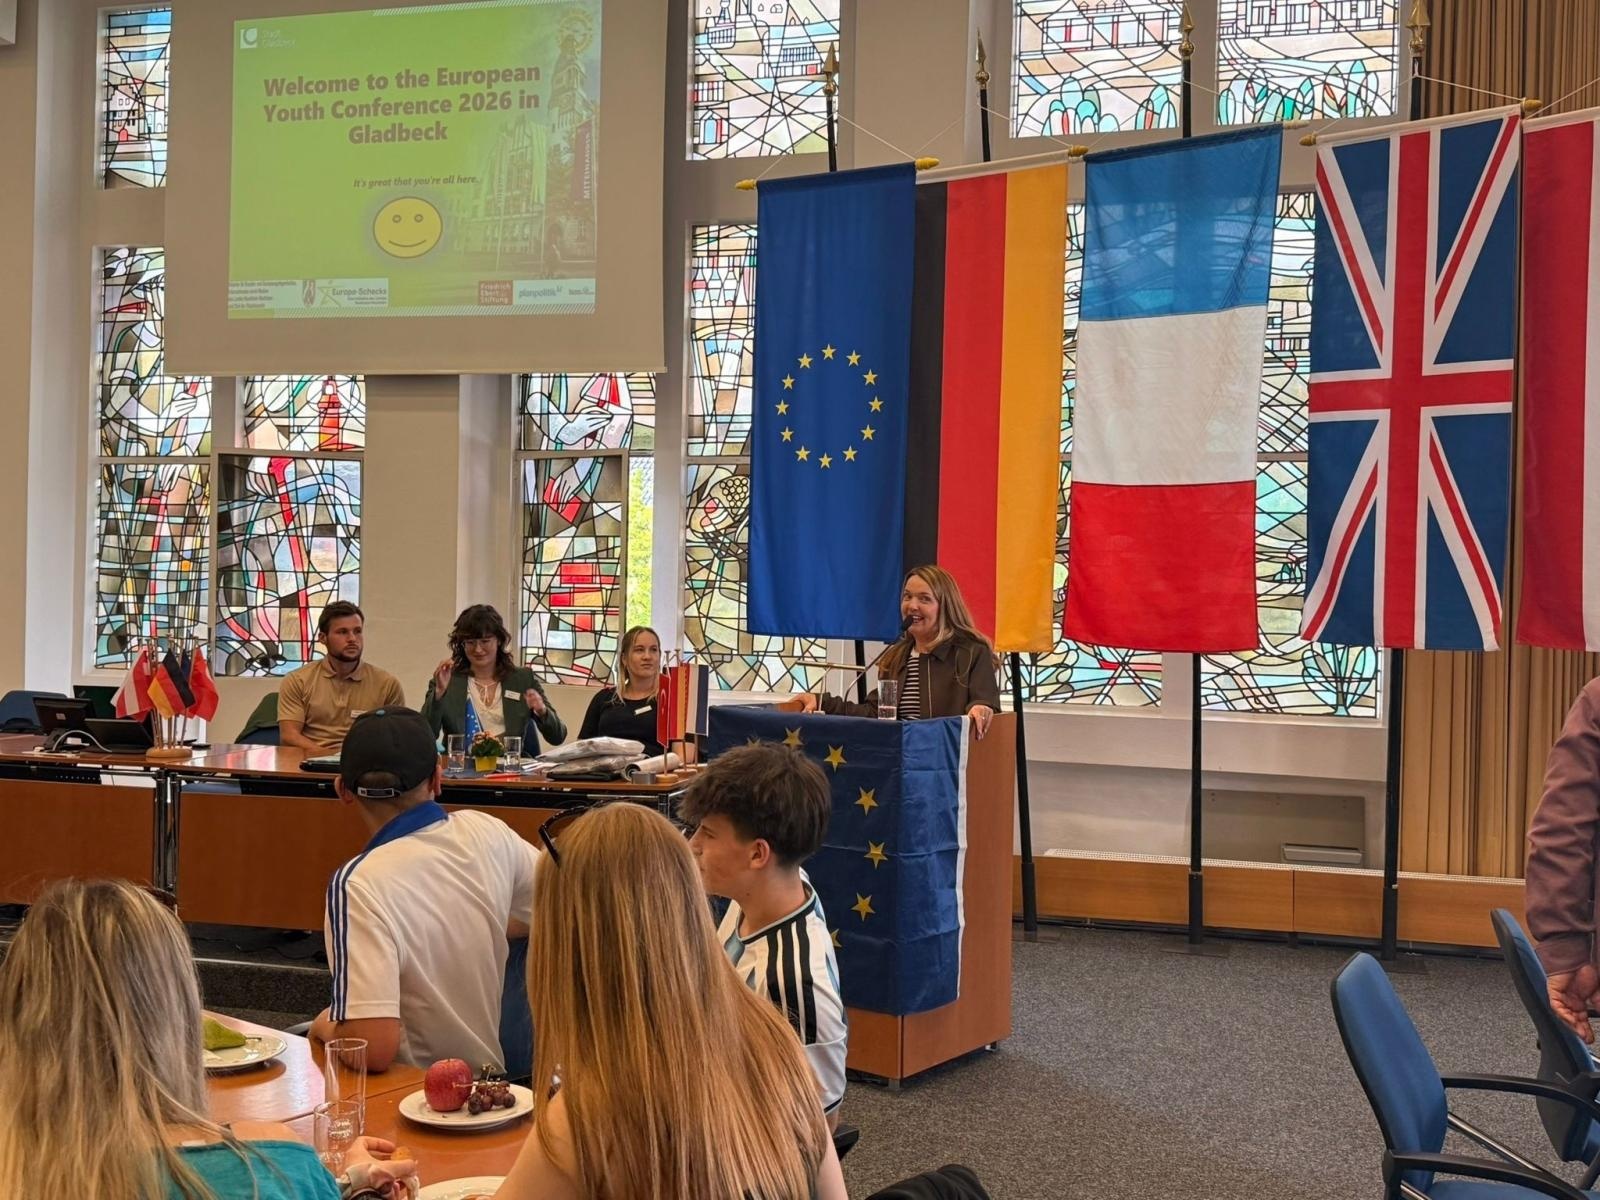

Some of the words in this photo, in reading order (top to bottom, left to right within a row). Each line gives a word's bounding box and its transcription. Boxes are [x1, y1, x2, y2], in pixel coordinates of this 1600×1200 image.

[263, 76, 360, 97] Welcome
[366, 74, 389, 90] to
[396, 69, 430, 89] the
[437, 66, 540, 89] European
[263, 101, 325, 122] Youth
[331, 97, 452, 119] Conference
[458, 90, 512, 112] 2026
[519, 90, 540, 109] in
[348, 121, 448, 144] Gladbeck
[353, 179, 367, 188] It's
[368, 179, 392, 190] great
[394, 176, 412, 187] that
[414, 175, 441, 188] you're
[442, 175, 455, 185] all
[457, 174, 481, 185] here.
